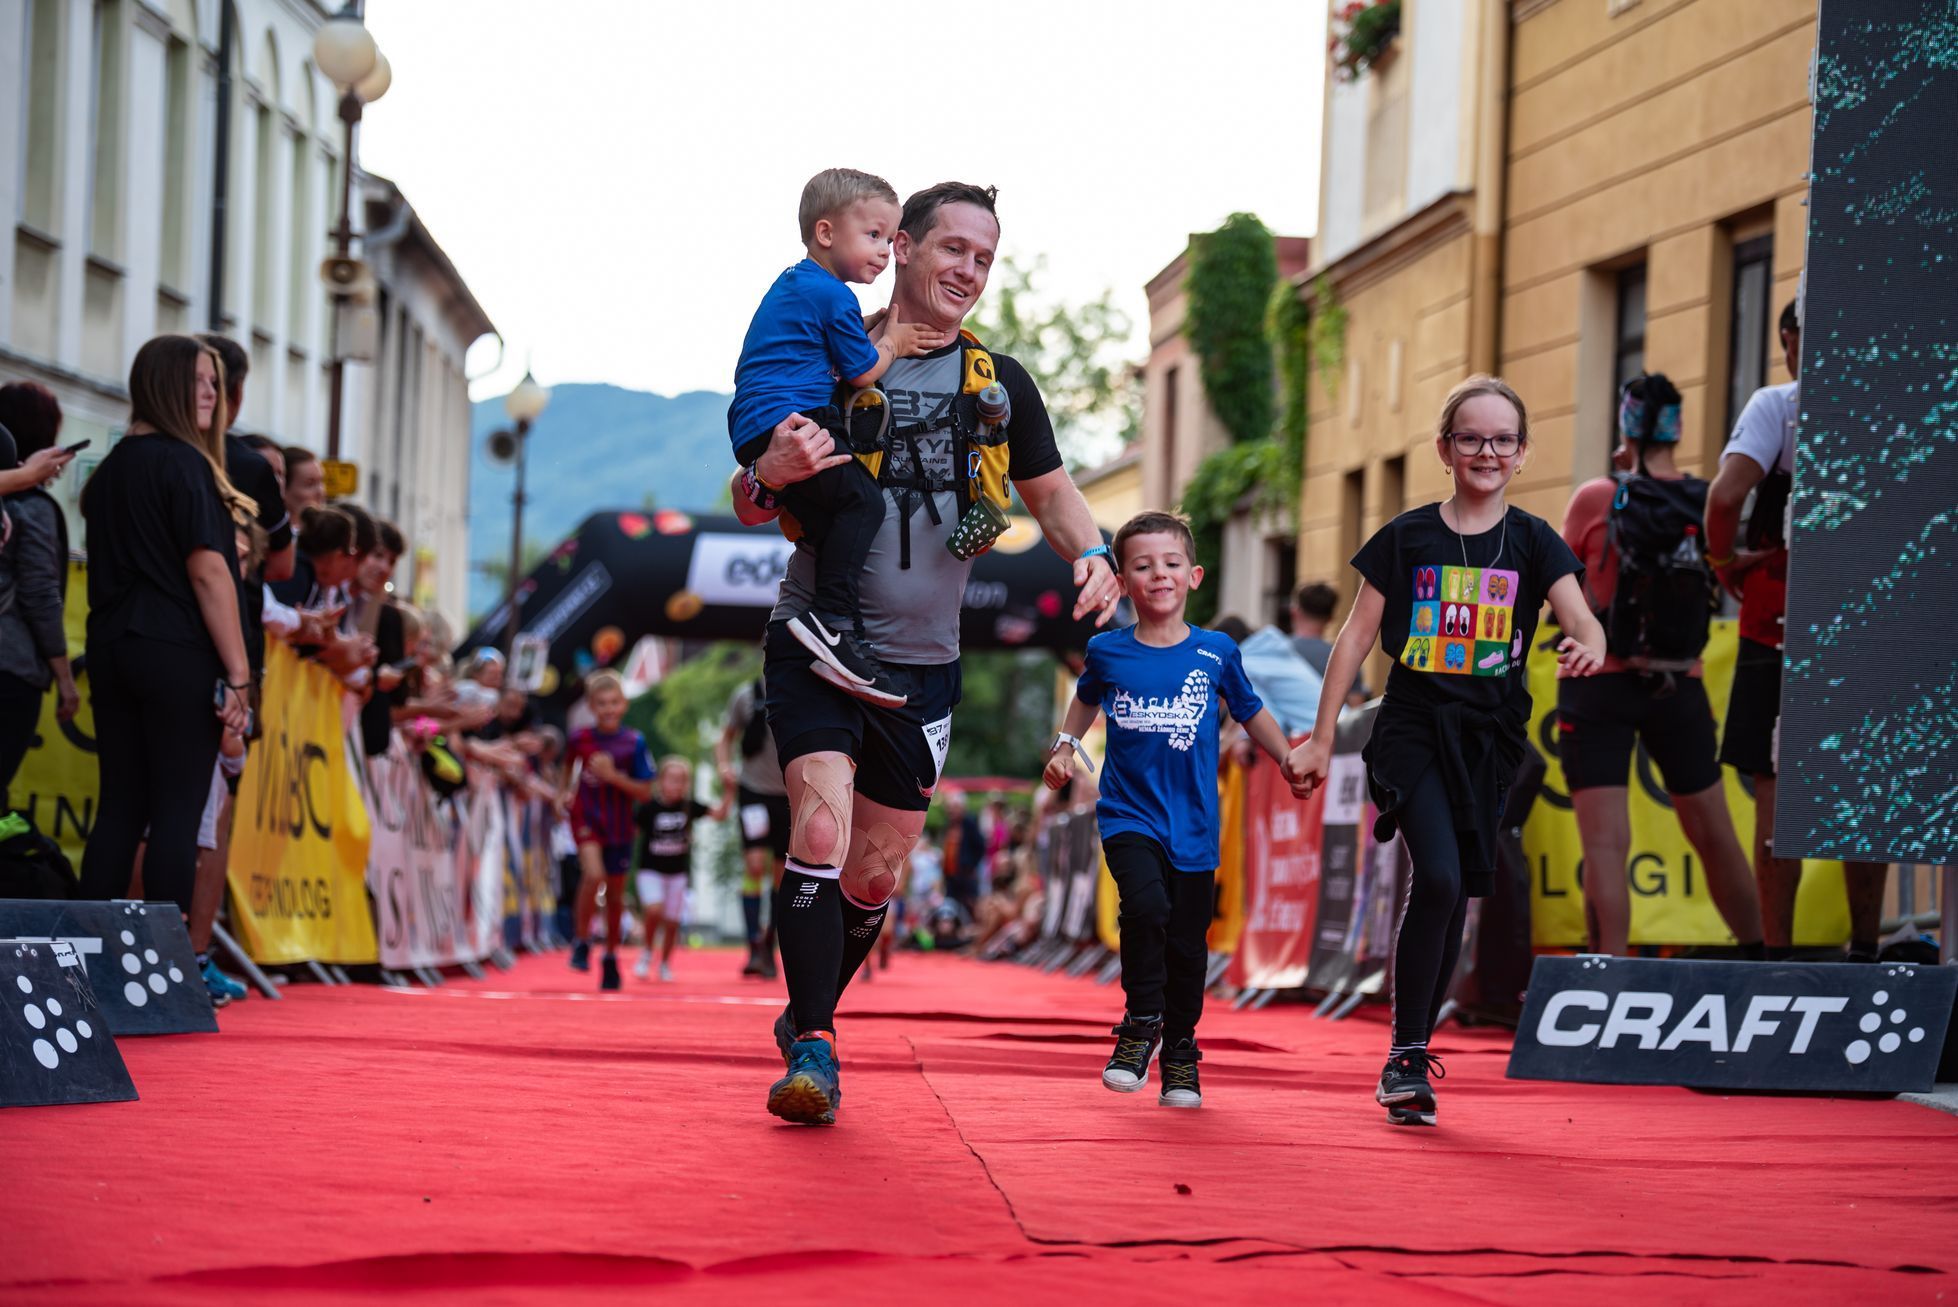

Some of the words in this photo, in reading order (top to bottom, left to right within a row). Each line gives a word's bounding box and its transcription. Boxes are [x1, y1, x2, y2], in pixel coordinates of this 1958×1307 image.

[1197, 648, 1221, 662] CRAFT
[1188, 702, 1205, 719] 7
[1535, 989, 1850, 1054] CRAFT
